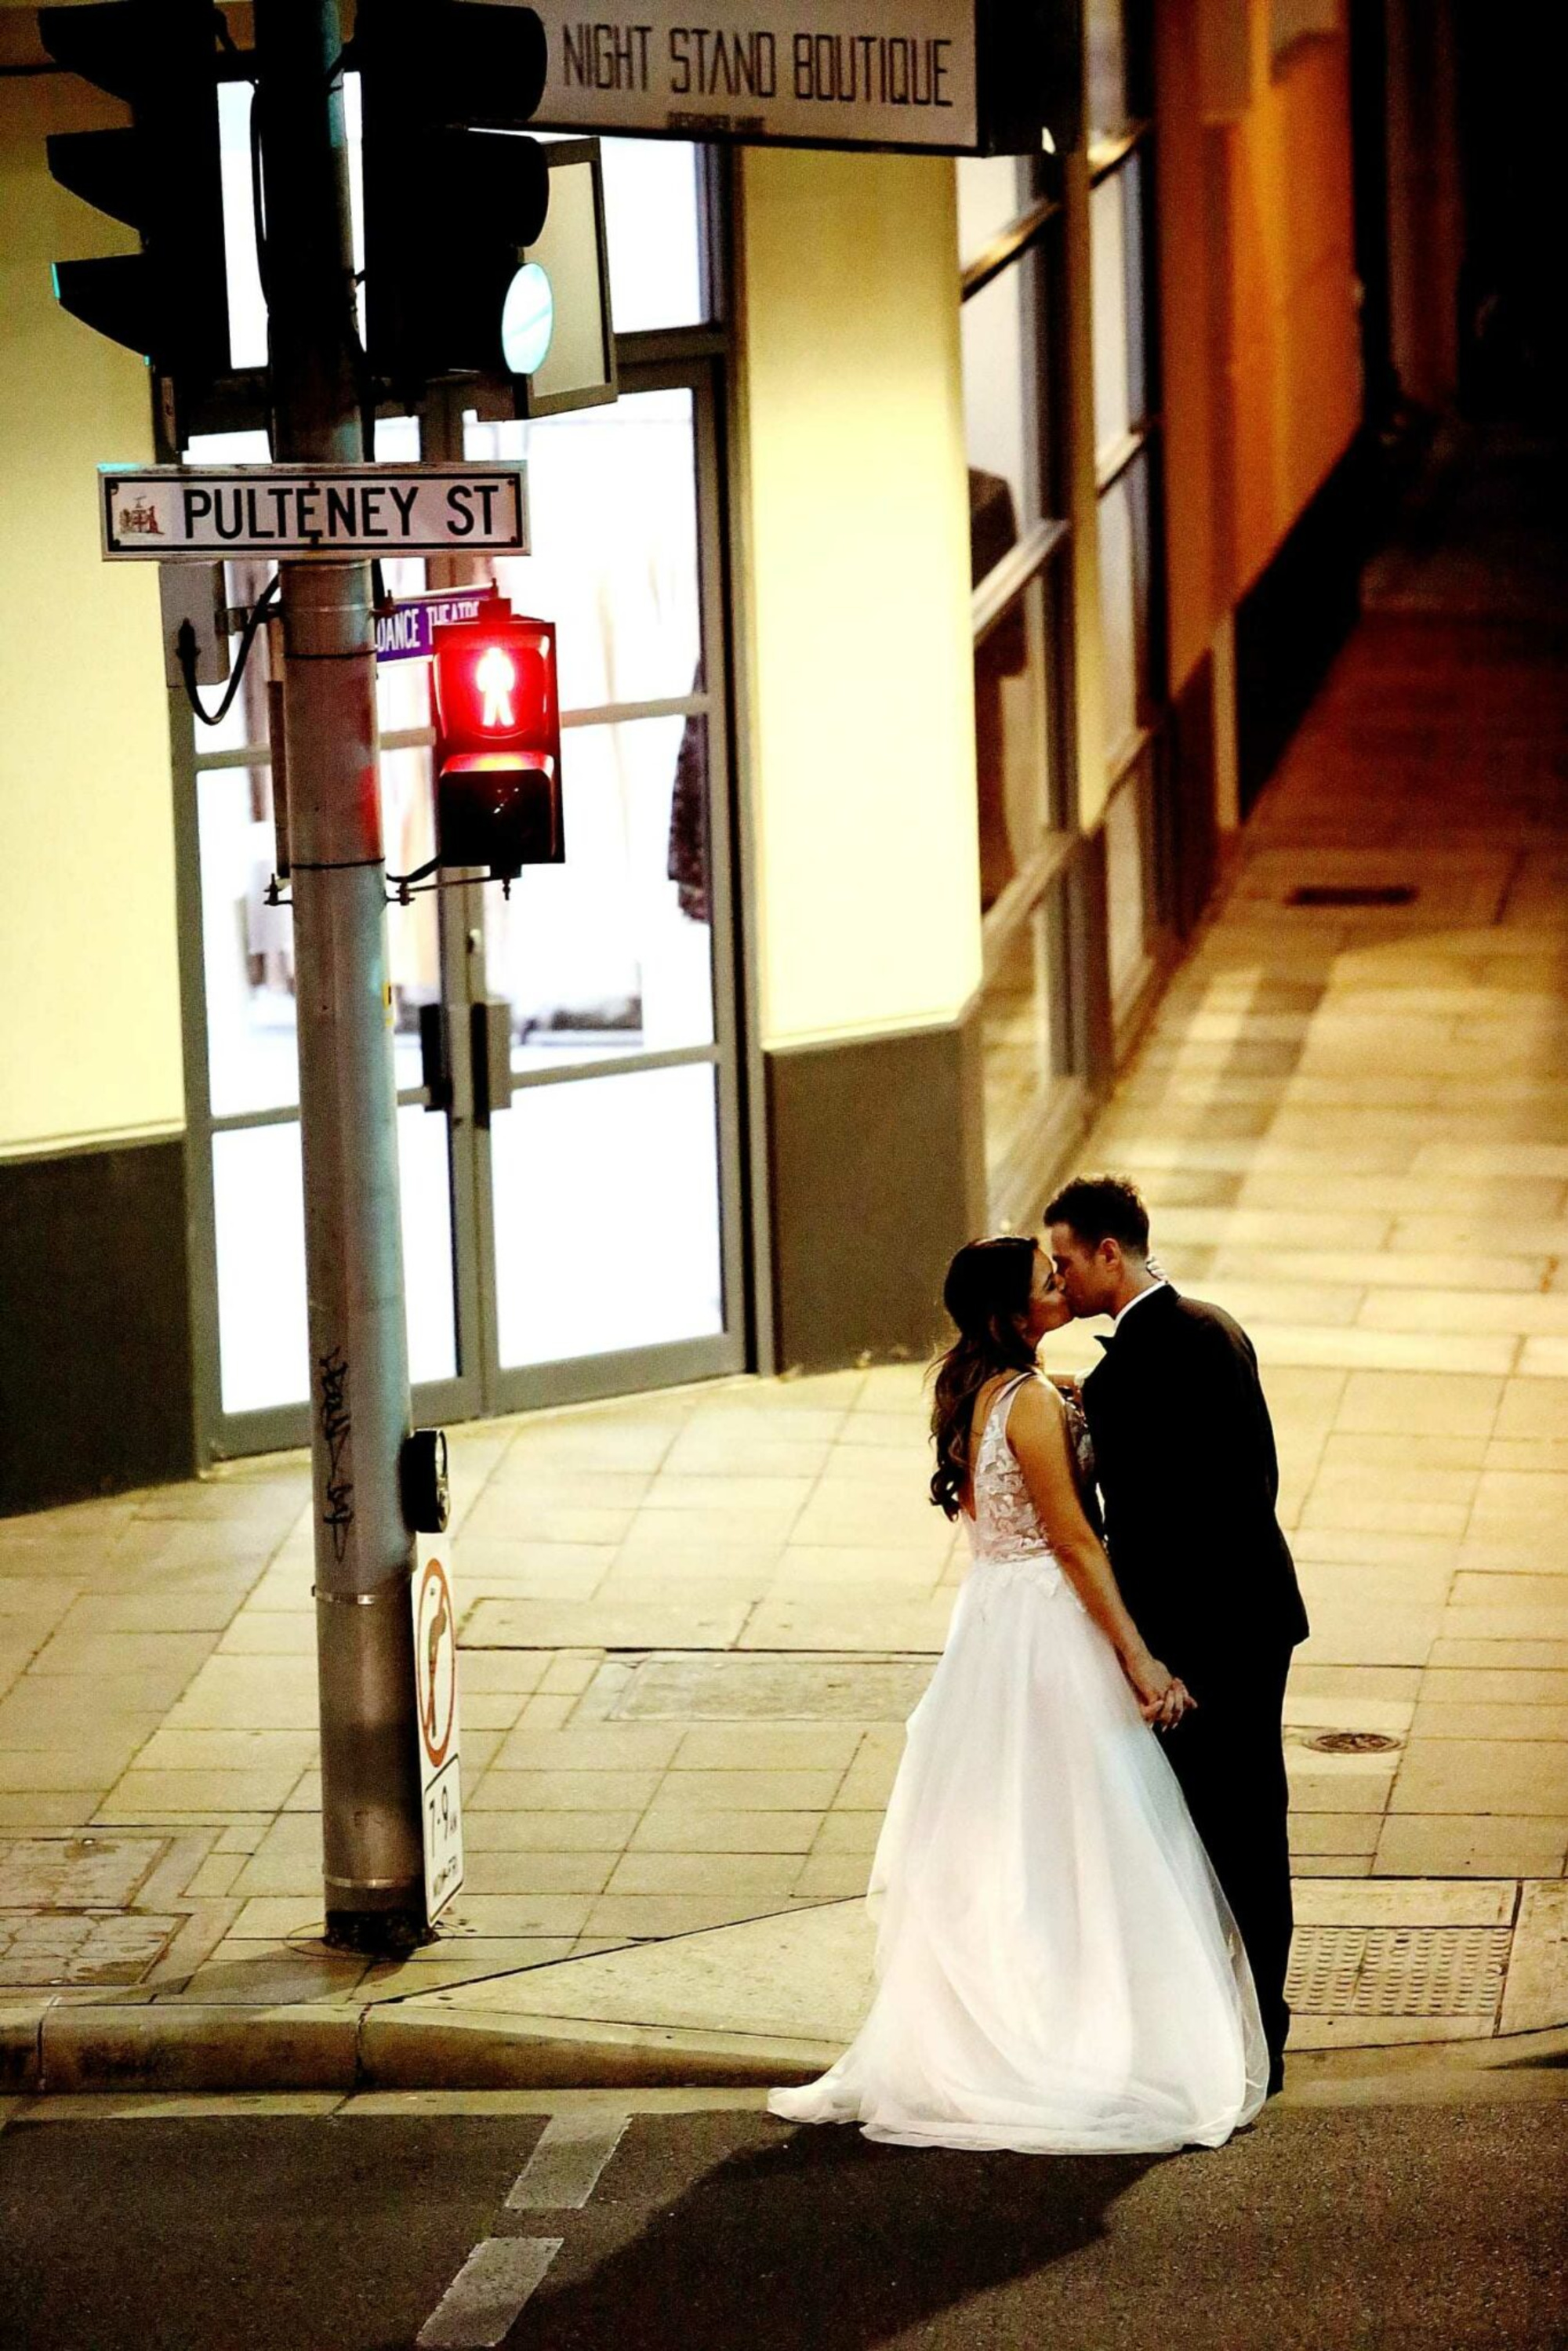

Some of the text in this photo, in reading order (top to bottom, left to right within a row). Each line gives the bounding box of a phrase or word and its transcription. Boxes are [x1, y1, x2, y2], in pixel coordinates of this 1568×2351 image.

[562, 23, 953, 108] NIGHT STAND BOUTIQUE
[184, 484, 499, 539] PULTENEY ST
[378, 608, 420, 651] DANCE
